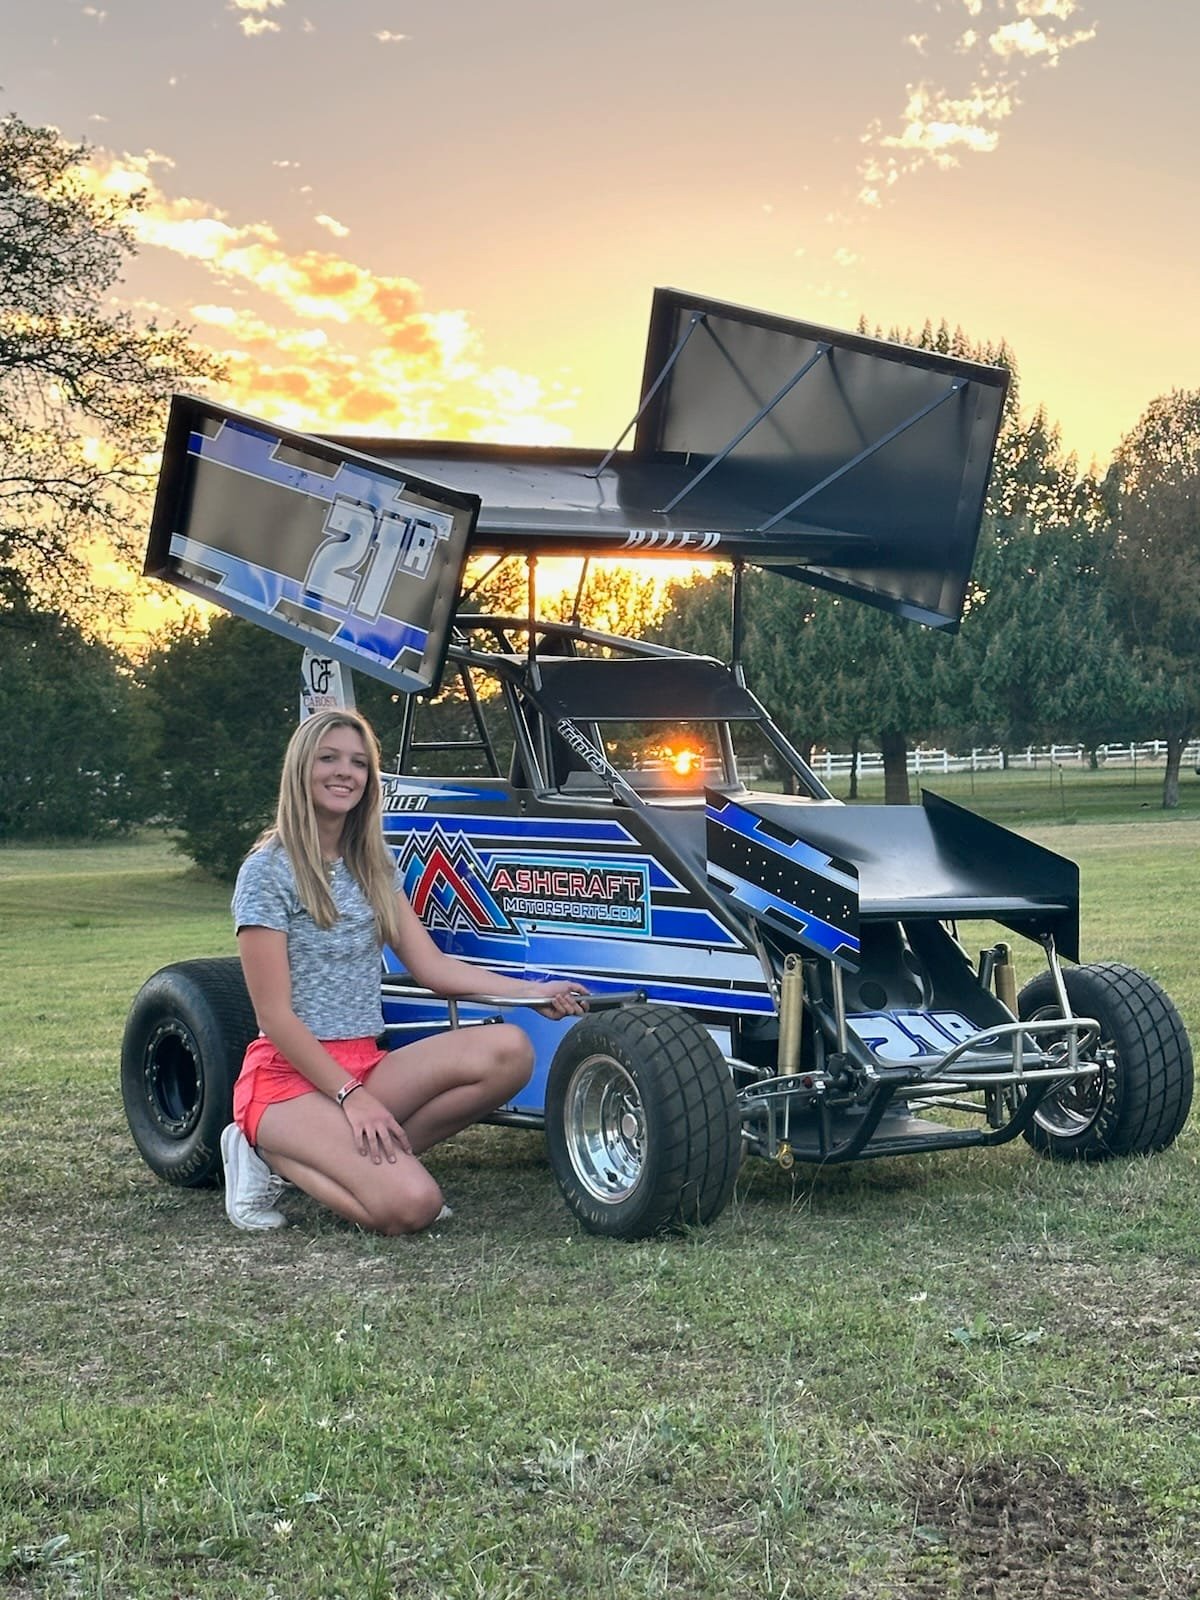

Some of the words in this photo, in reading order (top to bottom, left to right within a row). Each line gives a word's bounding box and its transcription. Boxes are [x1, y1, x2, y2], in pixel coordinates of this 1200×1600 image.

[303, 493, 439, 624] 21R
[491, 868, 641, 901] ASHCRAFT
[503, 896, 642, 923] MOTORSPORTS.COM
